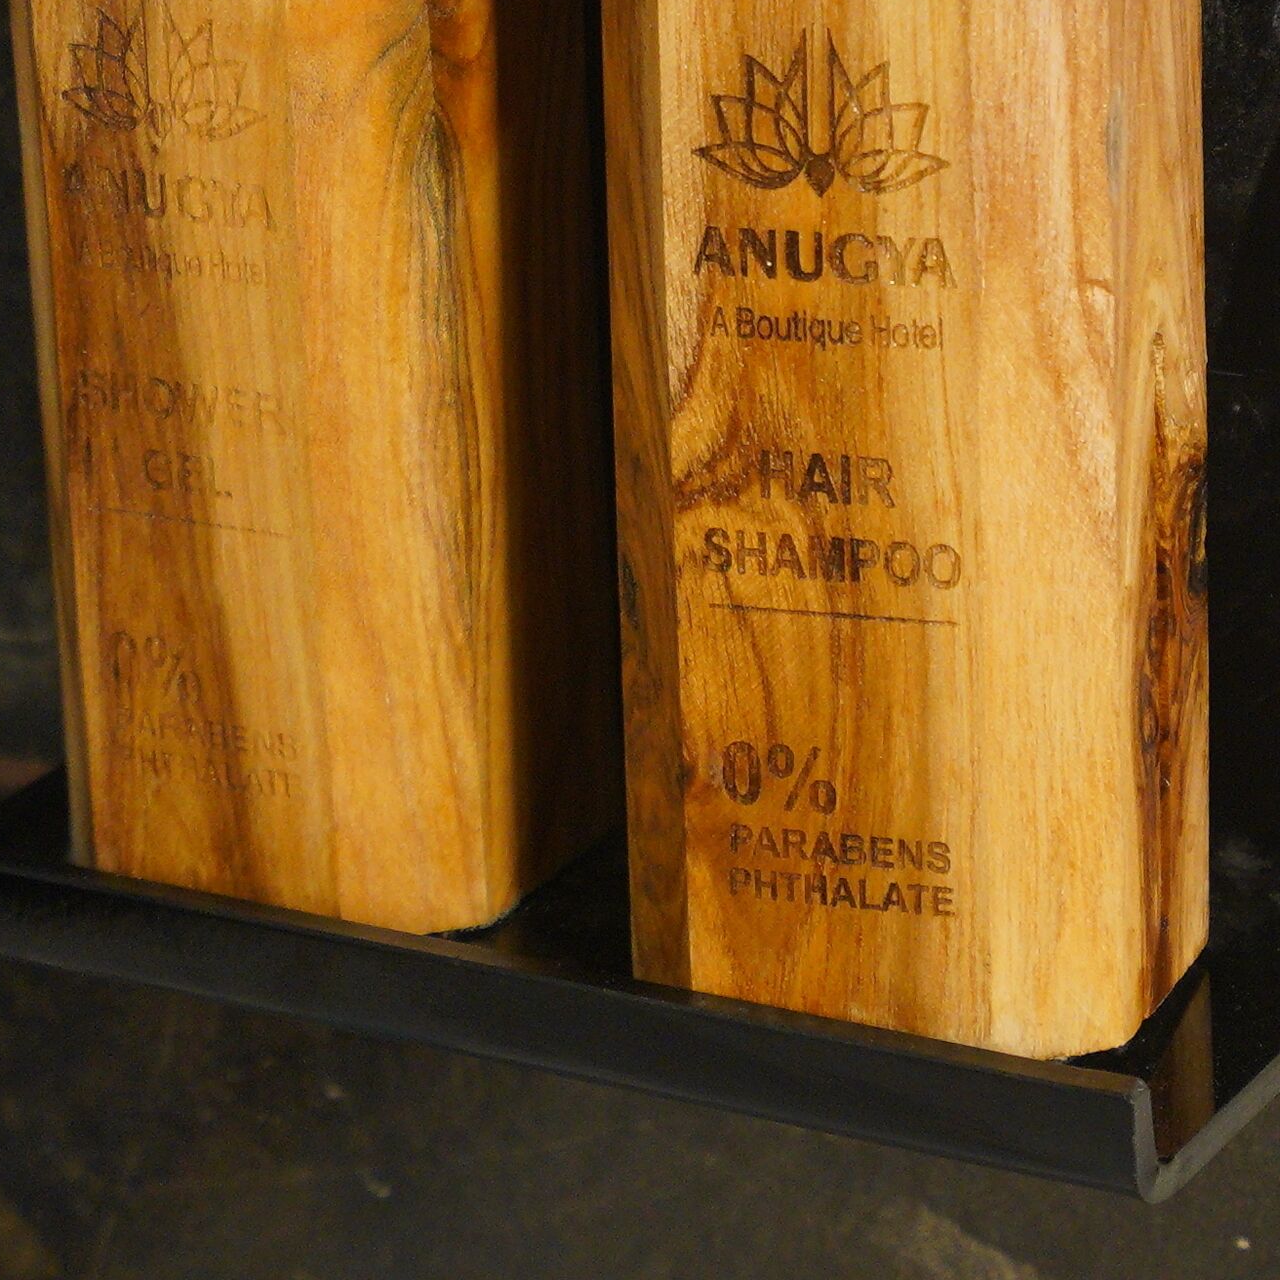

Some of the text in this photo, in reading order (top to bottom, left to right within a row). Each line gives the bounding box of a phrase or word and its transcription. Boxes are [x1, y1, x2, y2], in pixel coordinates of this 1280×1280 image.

[694, 225, 958, 289] ANUGYA
[710, 306, 943, 351] A Boutique Hotel
[759, 449, 895, 509] HAIR
[702, 527, 962, 590] SHAMPOO
[722, 740, 837, 815] 0%
[729, 823, 952, 875] PARABENS
[729, 867, 955, 918] PHTHALATE
